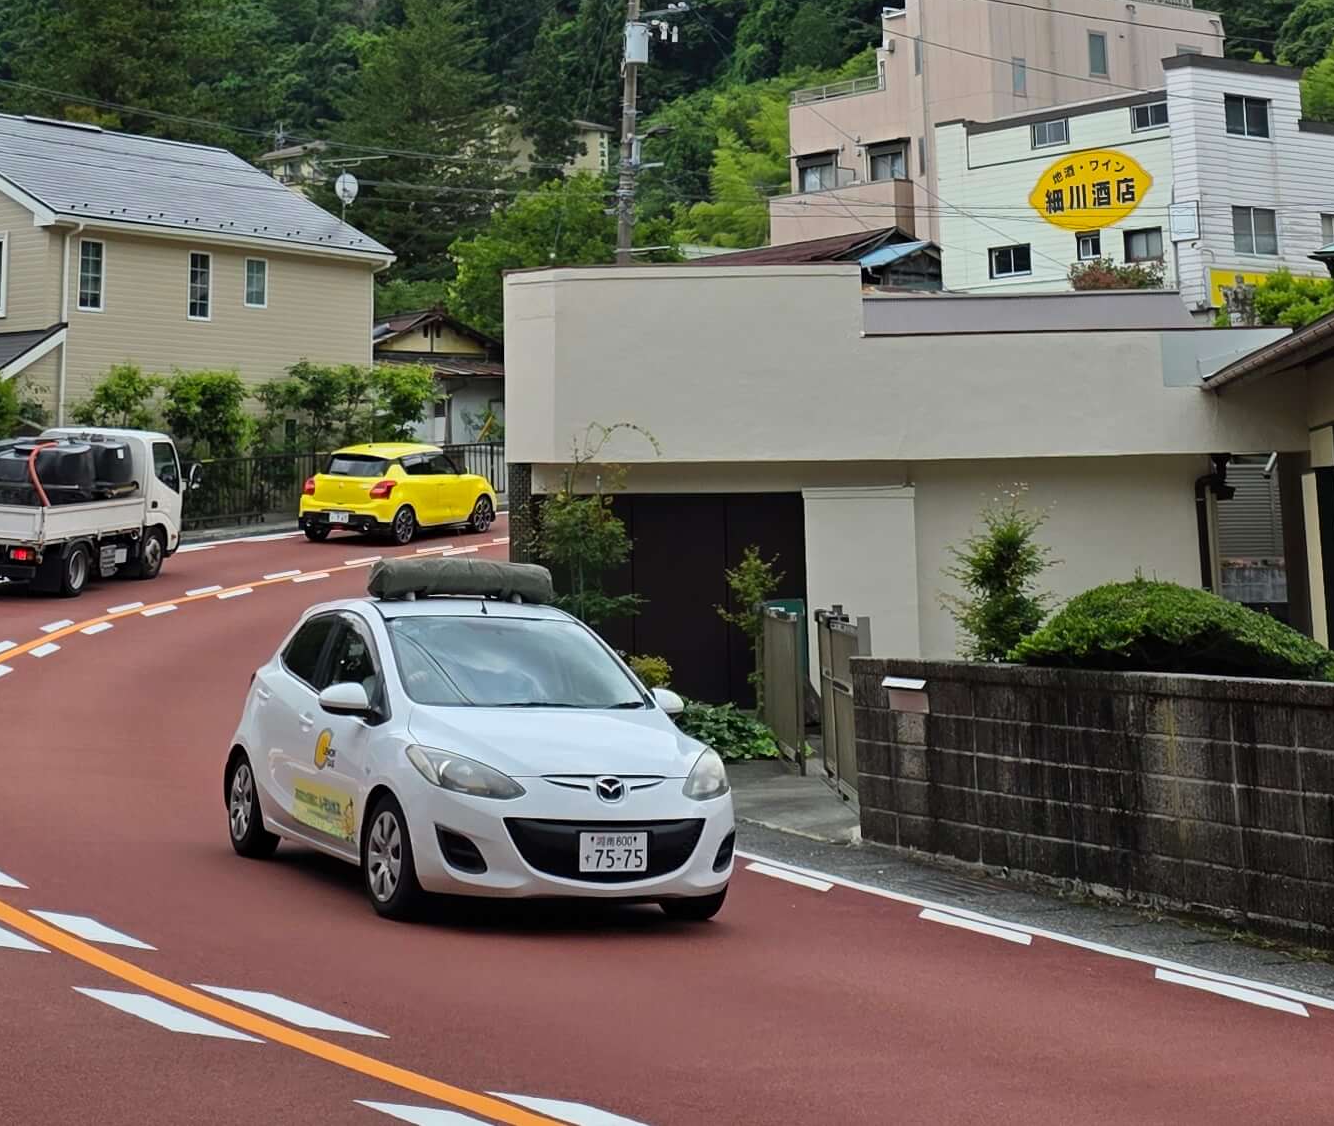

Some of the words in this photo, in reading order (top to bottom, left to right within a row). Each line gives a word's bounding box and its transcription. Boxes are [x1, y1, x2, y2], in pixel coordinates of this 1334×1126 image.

[1052, 160, 1125, 184] 地酒・ワイン
[1045, 177, 1136, 214] 細川酒店
[595, 848, 644, 869] 75-75
